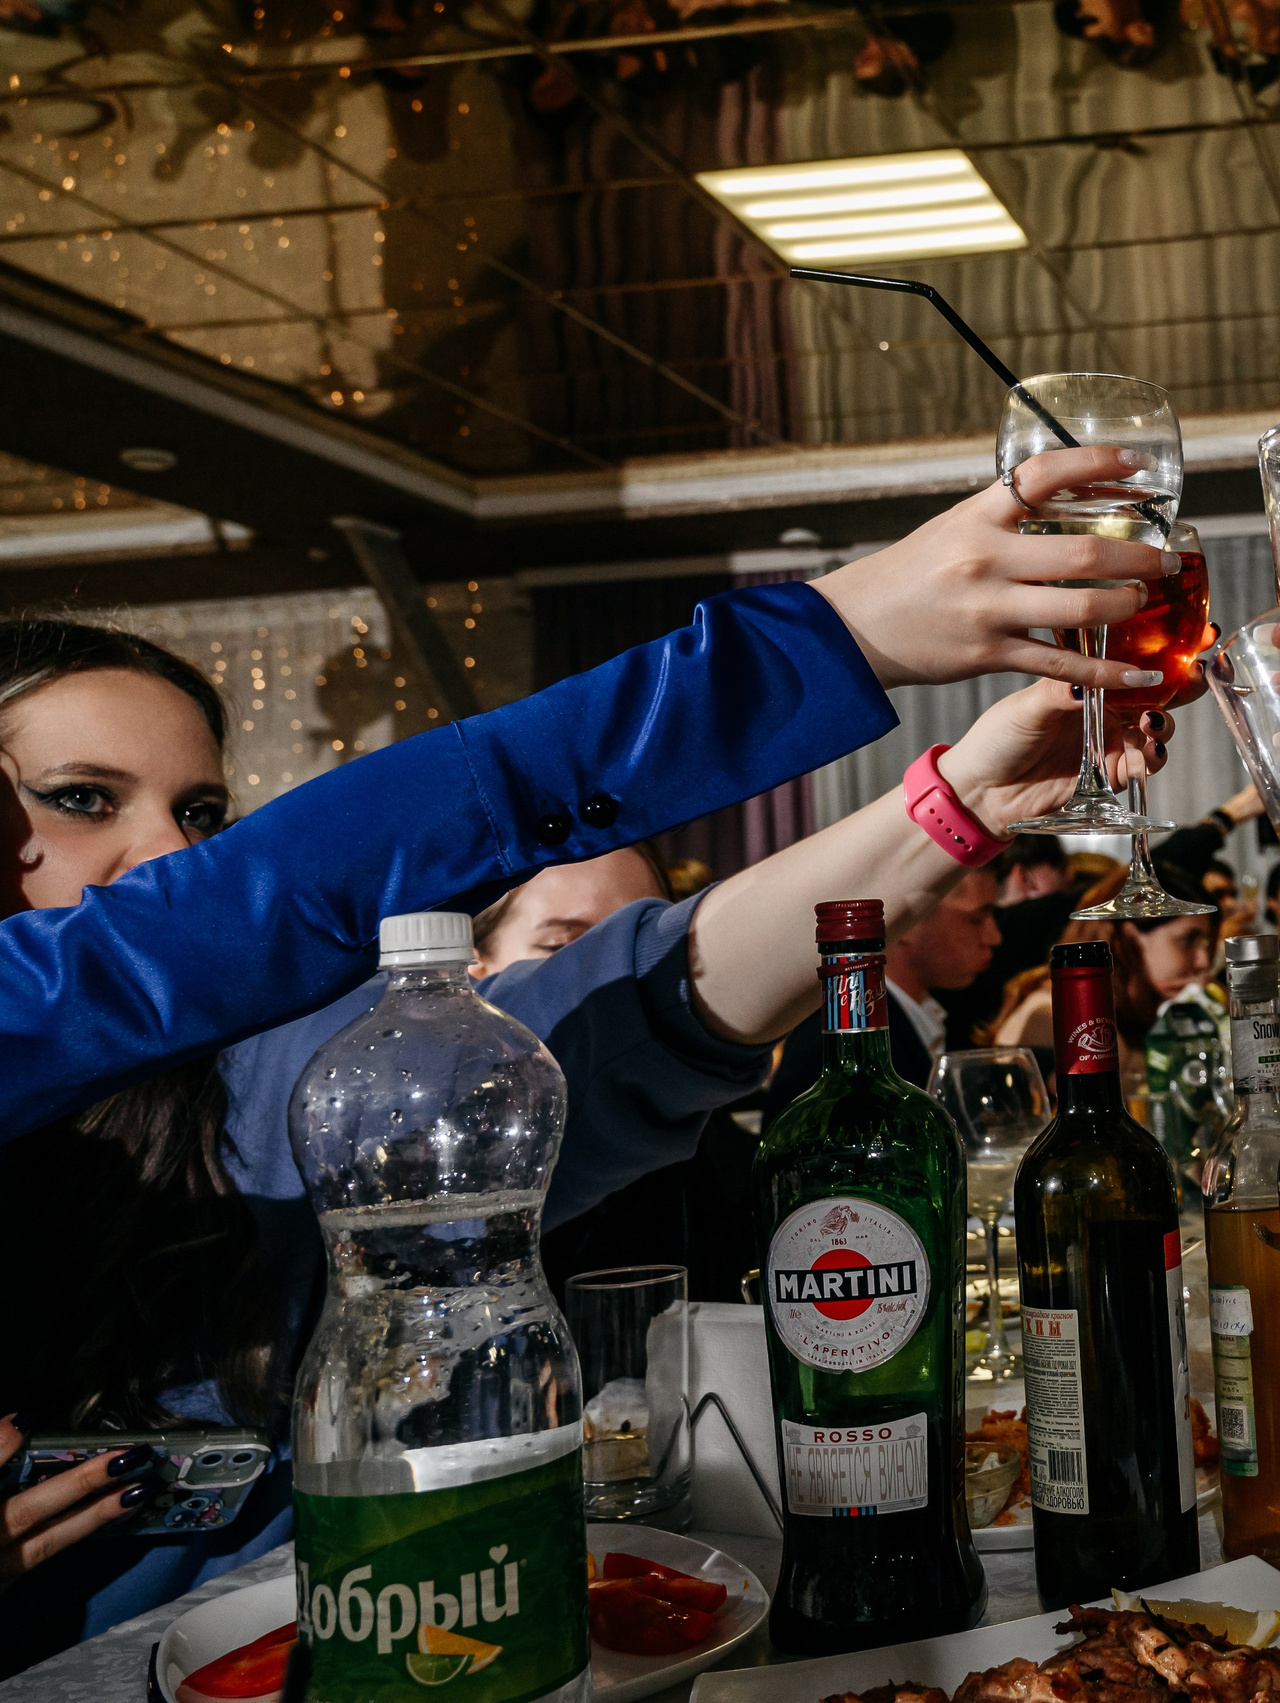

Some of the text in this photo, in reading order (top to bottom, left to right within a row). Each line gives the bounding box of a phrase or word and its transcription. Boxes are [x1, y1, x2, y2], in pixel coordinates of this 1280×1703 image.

[1068, 1022, 1088, 1044] WINES
[790, 1217, 893, 1240] TORINO ITALIA
[831, 1238, 848, 1246] 1863
[779, 1265, 911, 1300] MARTINI
[815, 1325, 846, 1337] MARTINI
[855, 1321, 877, 1334] ROSSI
[802, 1331, 891, 1357] L'APERITIVO
[866, 1348, 887, 1361] ITALIA
[814, 1427, 892, 1443] ROSSO
[788, 1439, 927, 1503] НЕ ЯВЛЯЕТСЯ ВИНОМ
[1046, 1494, 1085, 1510] ЗДОРОВЬЮ
[297, 1544, 520, 1655] Добрый
